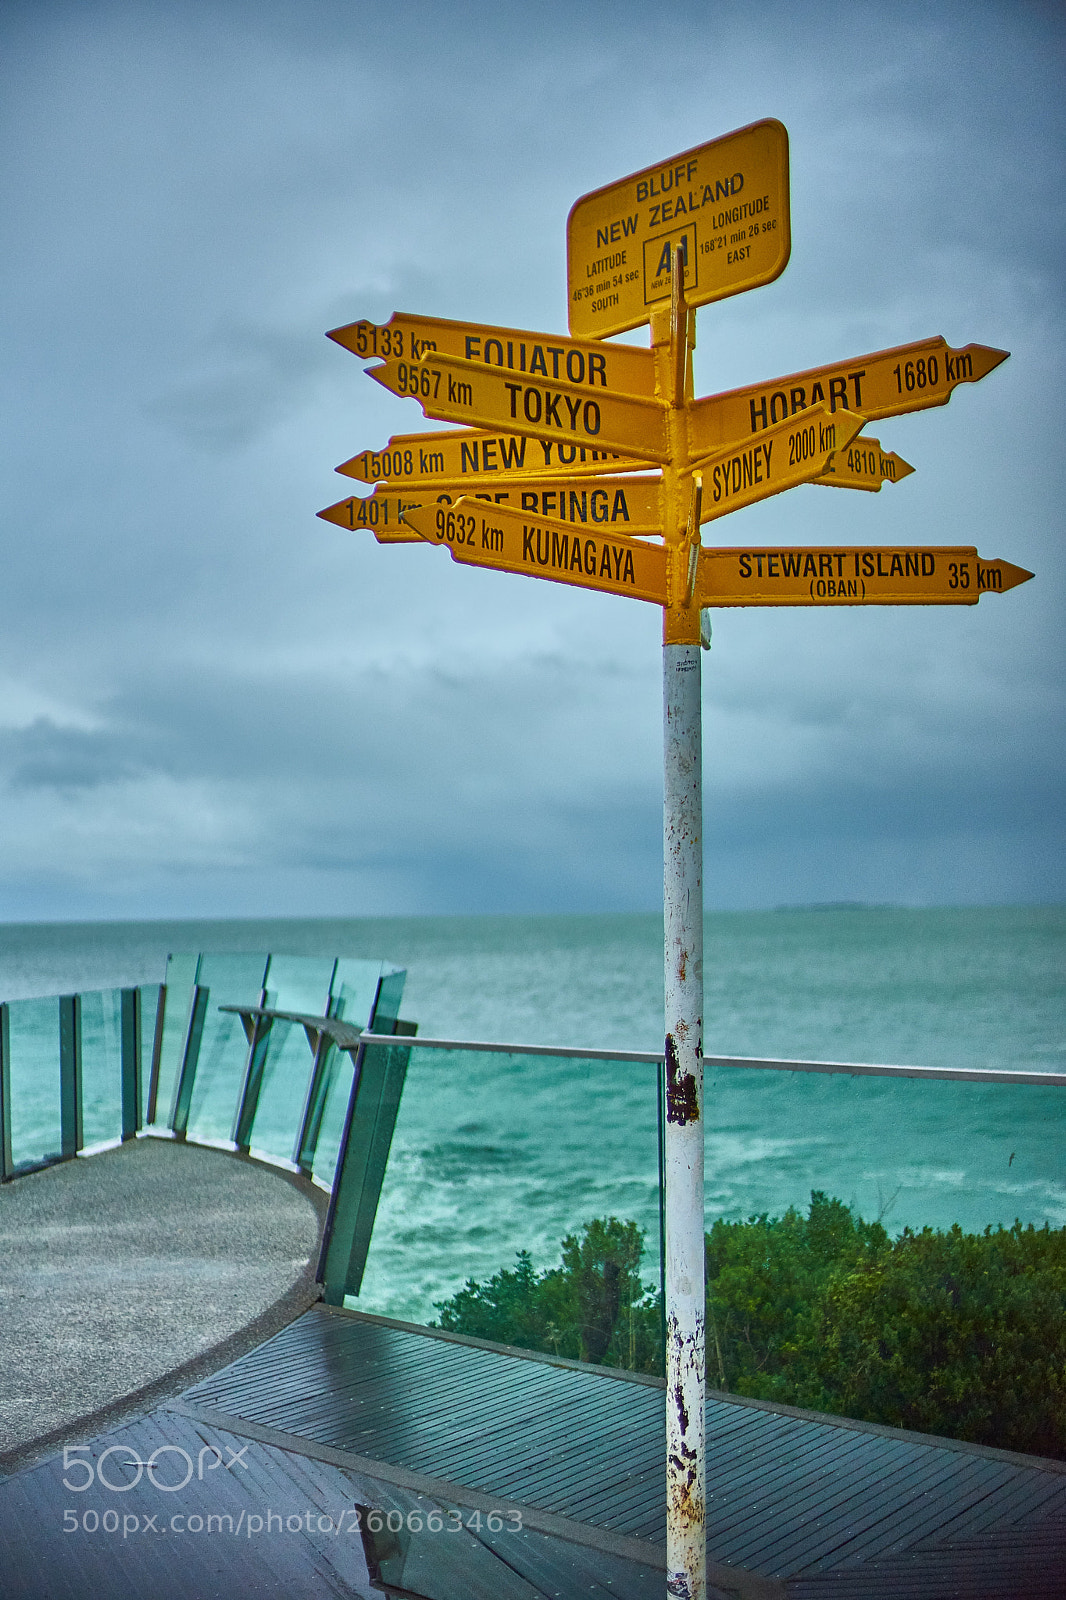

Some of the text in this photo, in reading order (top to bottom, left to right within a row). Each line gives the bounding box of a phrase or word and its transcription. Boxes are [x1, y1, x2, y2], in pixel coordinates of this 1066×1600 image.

[636, 158, 698, 202] BLUFF
[597, 172, 744, 248] NEW ZEALAND
[712, 195, 770, 230] LONGITUDE
[730, 229, 746, 244] min
[748, 223, 760, 237] 26
[761, 219, 777, 233] sec
[586, 250, 627, 278] LATITUDE
[727, 245, 751, 265] EAST
[596, 280, 611, 293] min
[613, 273, 623, 287] 54
[625, 269, 639, 283] sec
[591, 293, 619, 313] SOUTH
[356, 324, 404, 358] 5133
[398, 362, 601, 435] 9567 km TOKYO
[749, 352, 973, 433] HOBART 1680 km
[361, 450, 413, 478] 15008
[419, 449, 444, 473] km
[461, 437, 526, 473] NEW
[712, 440, 774, 502] SYDNEY
[788, 425, 815, 466] 2000
[818, 422, 836, 454] km
[847, 448, 876, 475] 4810
[879, 453, 896, 477] km
[346, 499, 389, 526] 1401
[436, 509, 636, 584] 9632 km KUMAGAYA
[739, 553, 1002, 589] STEWART ISLAND 35 km
[809, 579, 866, 599] (OBAN)
